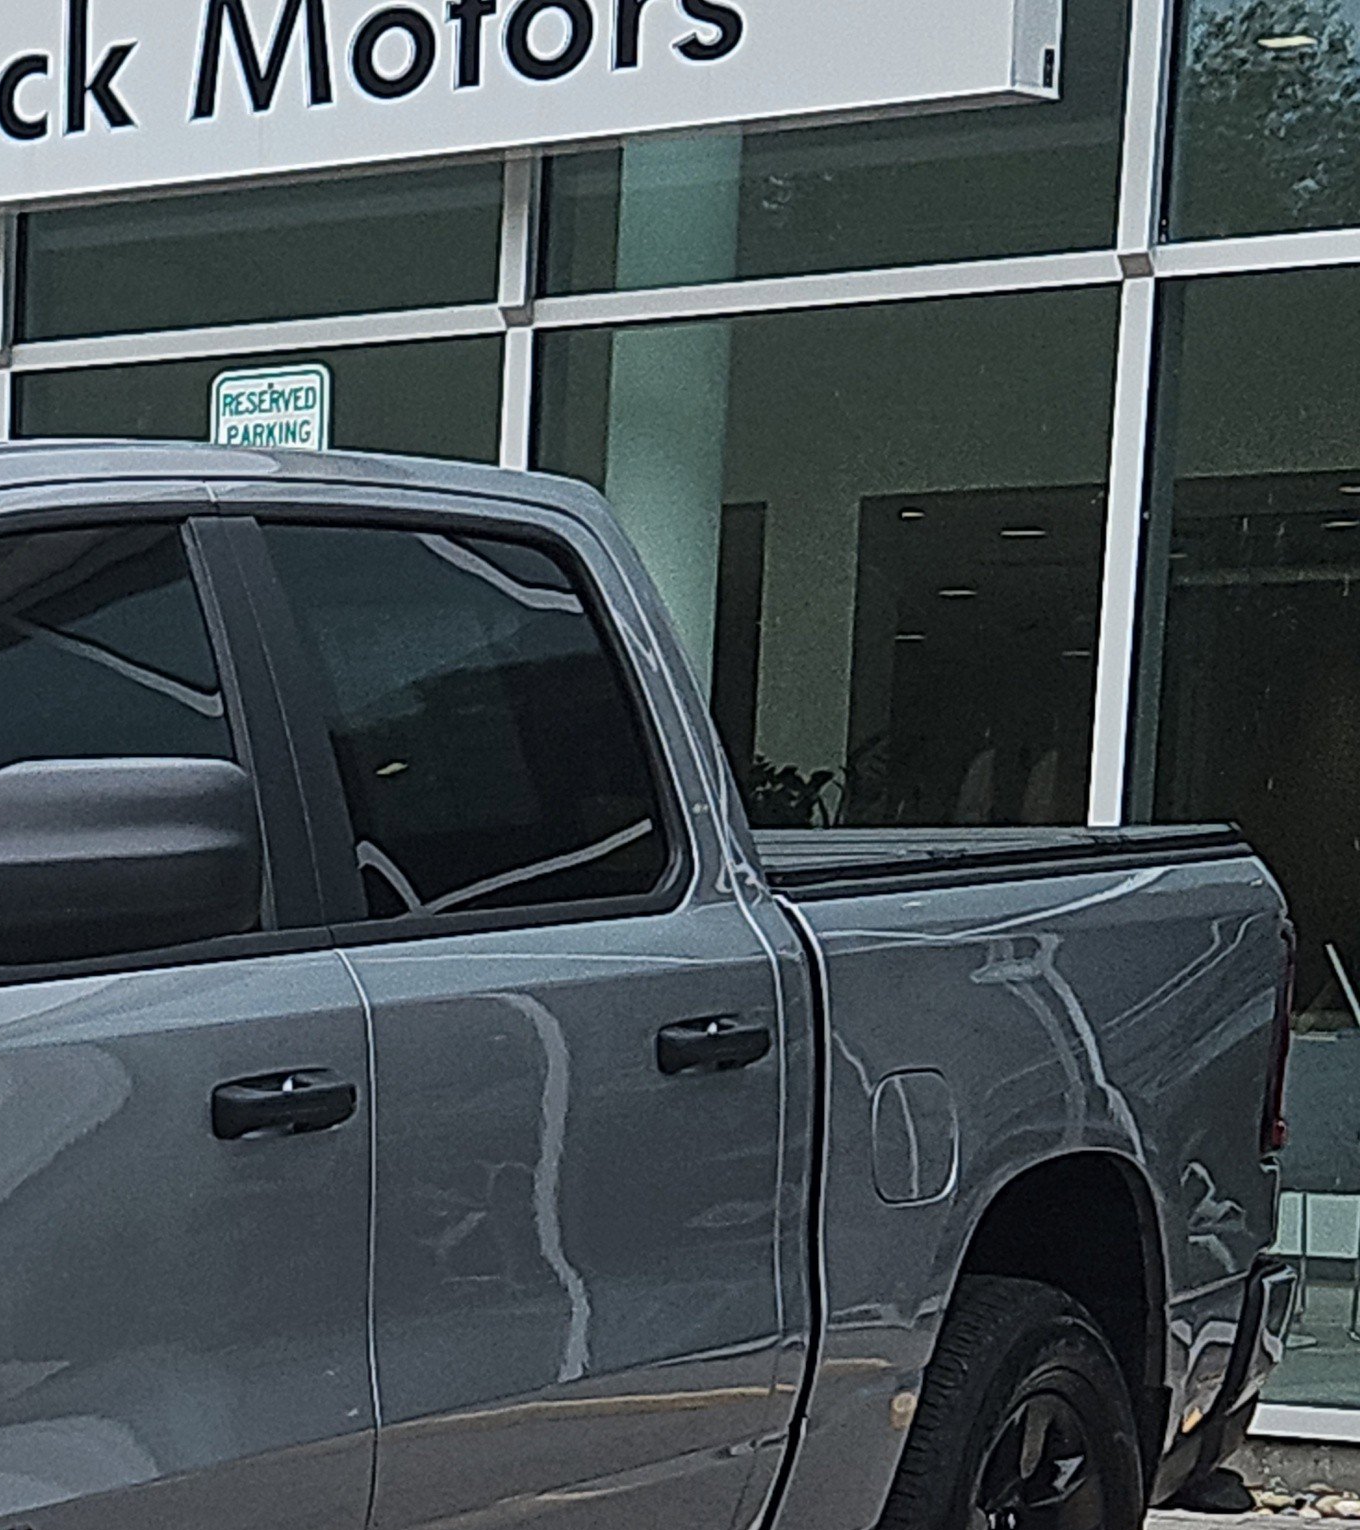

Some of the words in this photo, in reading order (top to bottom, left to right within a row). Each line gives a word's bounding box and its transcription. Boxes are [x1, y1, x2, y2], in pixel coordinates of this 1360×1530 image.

[189, 0, 744, 122] Motors
[222, 386, 317, 416] RESERVED
[227, 419, 311, 446] PARKING
